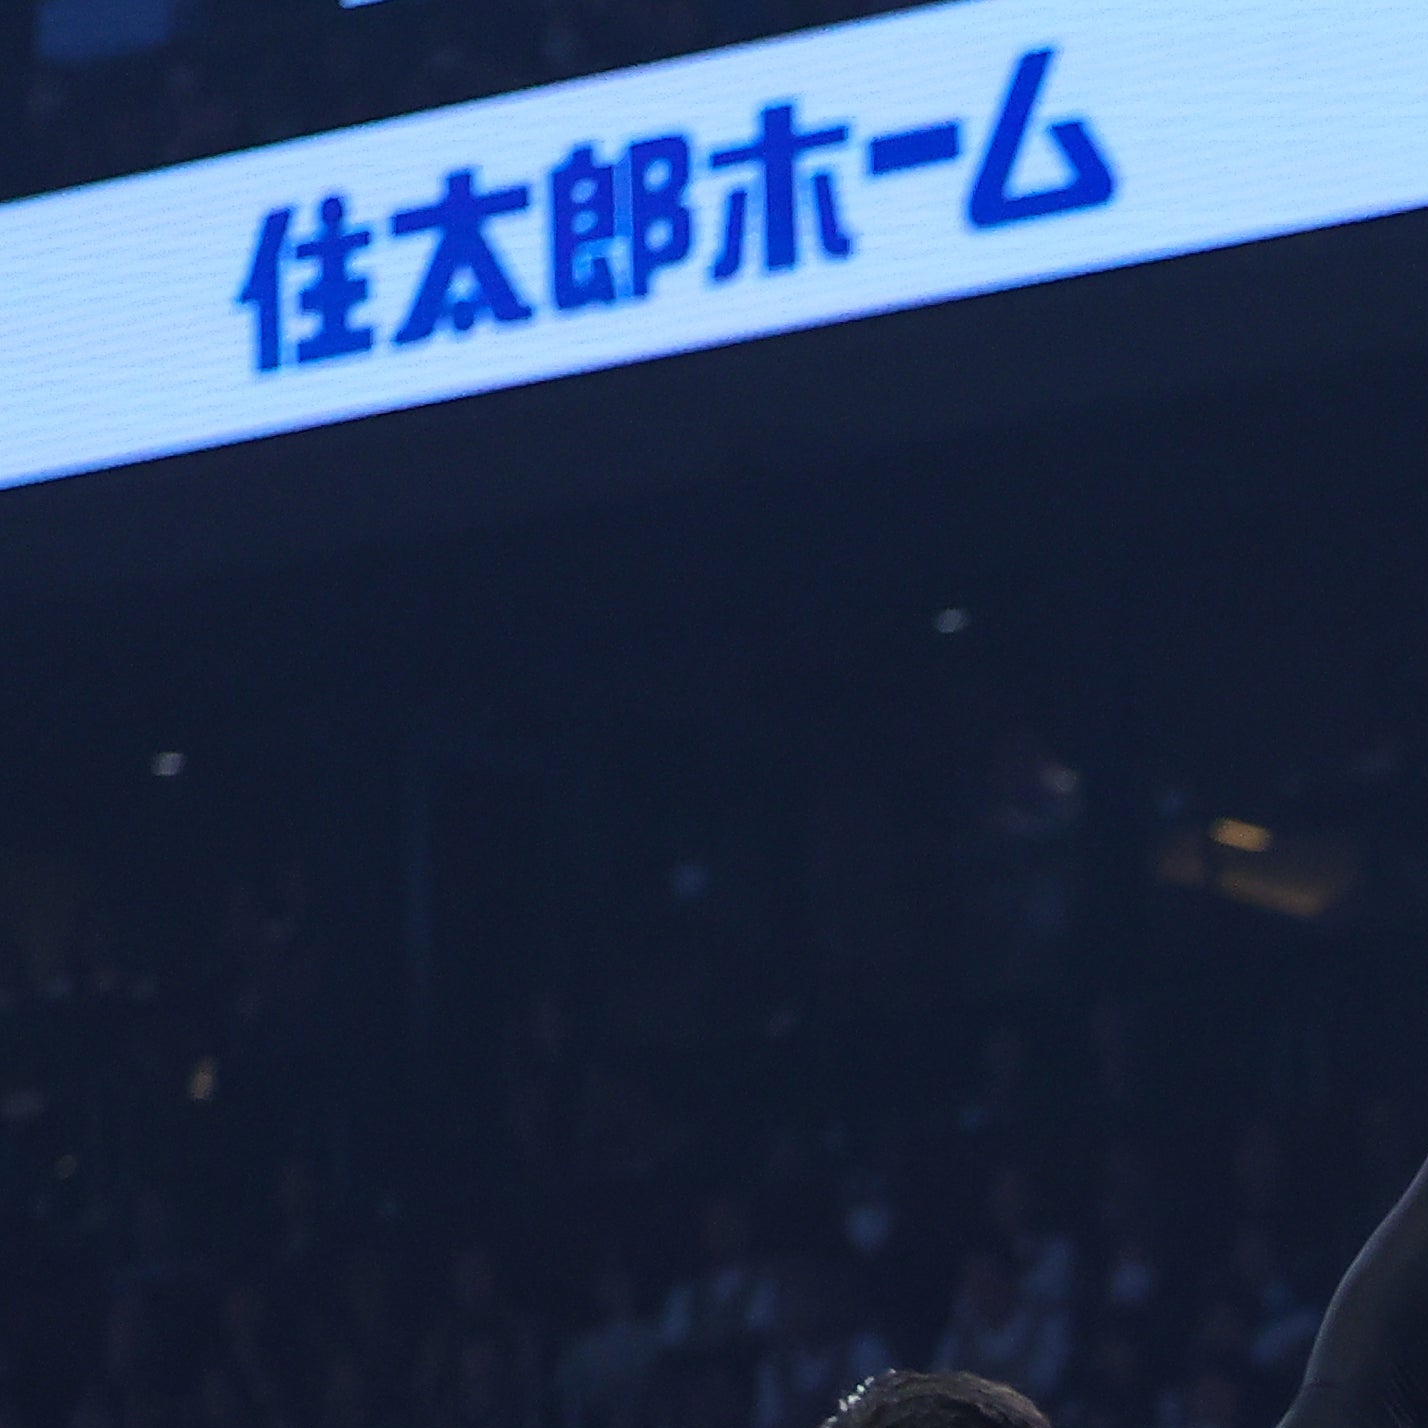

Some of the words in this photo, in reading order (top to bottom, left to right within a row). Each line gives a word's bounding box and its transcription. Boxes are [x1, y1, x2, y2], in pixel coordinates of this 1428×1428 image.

[236, 46, 1119, 376] 住太郎ホーム
